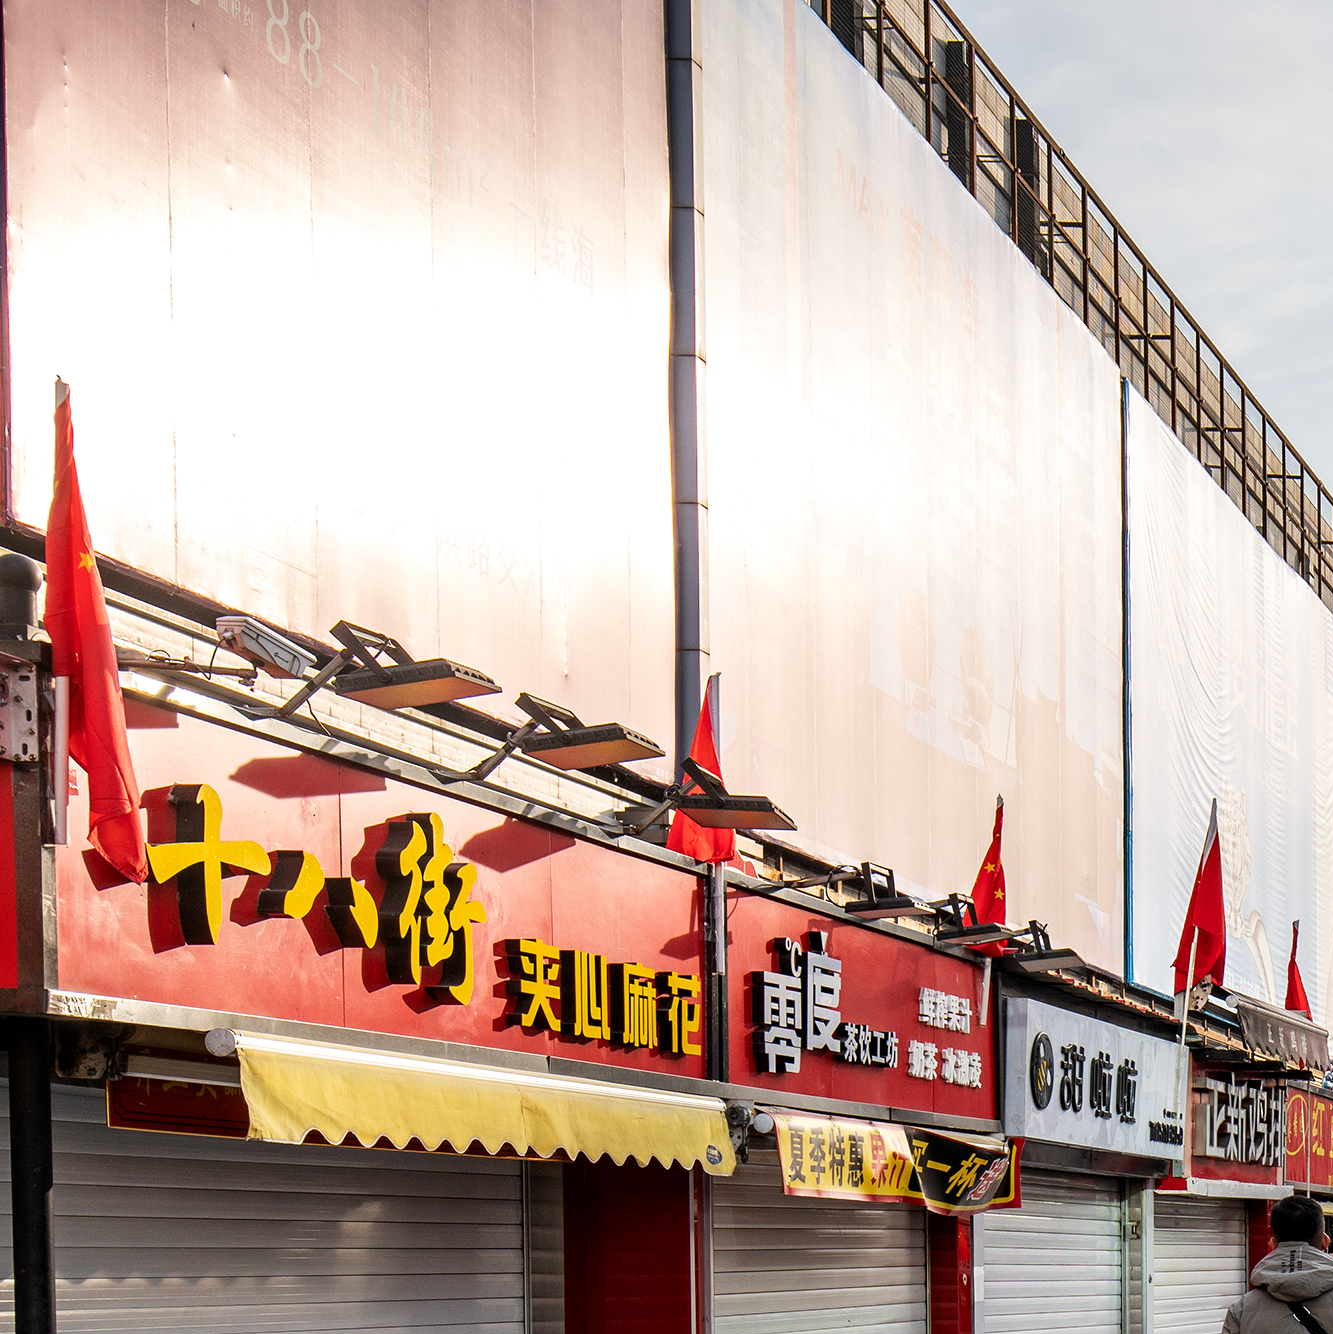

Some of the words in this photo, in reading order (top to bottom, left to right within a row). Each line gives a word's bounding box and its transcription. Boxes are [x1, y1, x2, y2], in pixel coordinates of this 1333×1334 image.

[147, 784, 486, 1005] 十八街
[520, 938, 703, 1055] 夹心麻花
[918, 986, 972, 1034] 鲜榨果汁
[844, 1022, 899, 1068] 茶饮工坊
[908, 1040, 938, 1080] 奶茶
[1060, 1043, 1139, 1125] 甜啦啦
